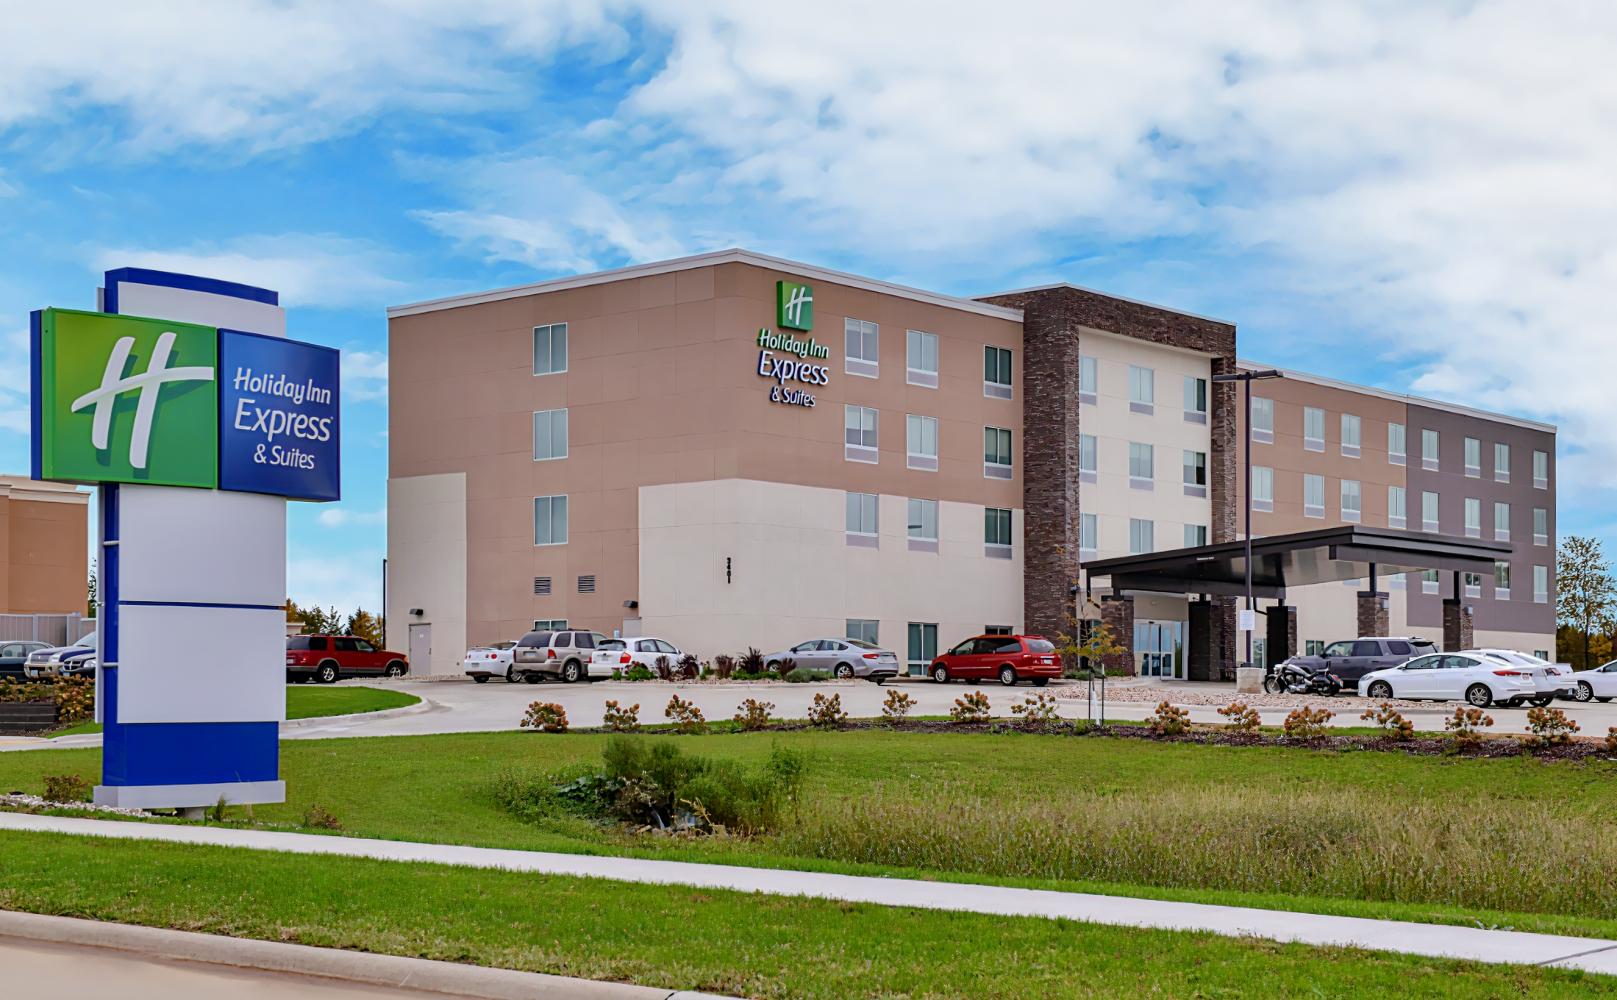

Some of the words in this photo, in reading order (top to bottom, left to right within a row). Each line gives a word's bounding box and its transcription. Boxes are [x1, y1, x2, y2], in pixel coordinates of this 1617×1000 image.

[759, 328, 808, 358] Holiday
[809, 337, 829, 359] Inn
[758, 350, 829, 386] Express
[233, 367, 305, 404] Holiday
[306, 378, 331, 404] Inn
[770, 386, 780, 402] &
[782, 387, 816, 407] Suites
[234, 397, 331, 442] Express
[253, 443, 267, 464] &
[269, 445, 315, 470] Suites
